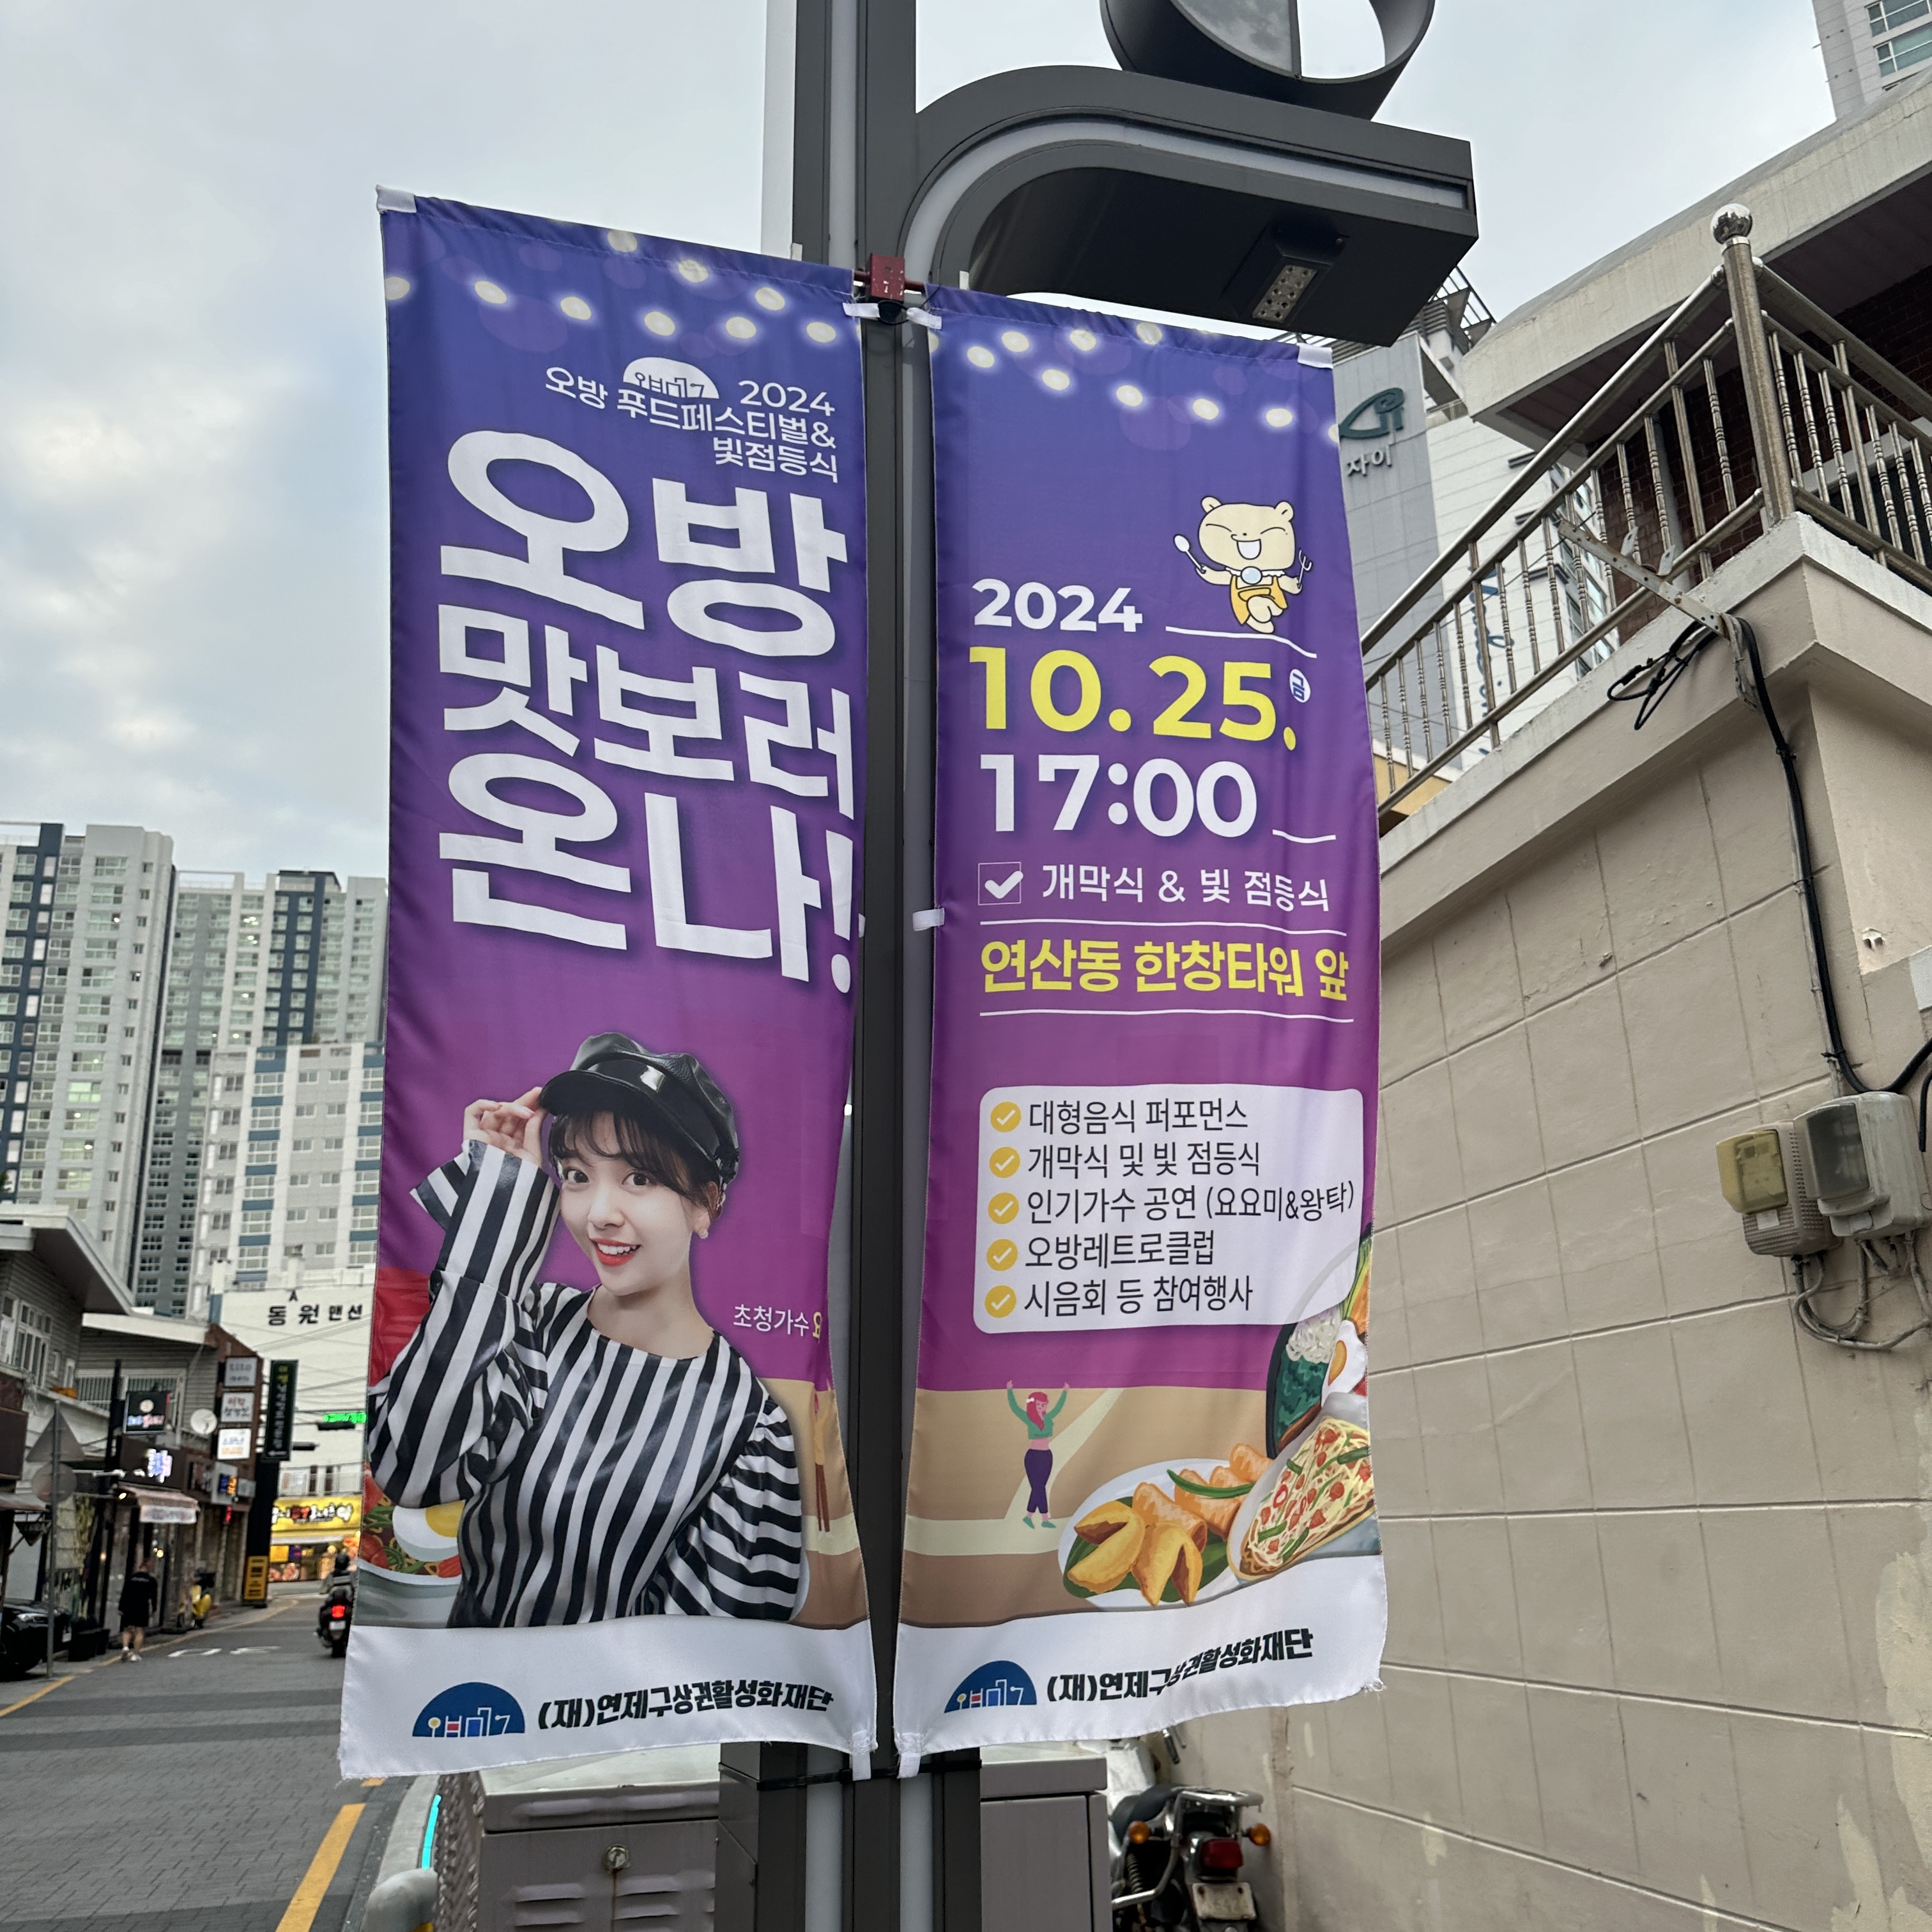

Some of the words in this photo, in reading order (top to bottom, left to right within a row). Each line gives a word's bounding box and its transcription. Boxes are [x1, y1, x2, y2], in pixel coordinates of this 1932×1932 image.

[546, 367, 608, 409] 오방
[738, 380, 835, 416] 2024
[713, 437, 838, 482] 빛점등식
[1347, 445, 1392, 477] 자이
[440, 430, 848, 657] 오방
[972, 578, 1143, 632] 2024
[438, 604, 854, 820] 맛보러
[981, 754, 1257, 838] 17:00
[439, 753, 854, 993] 온나!
[1042, 864, 1144, 903] 개막식
[1158, 870, 1186, 903] &
[1200, 869, 1230, 903] 빛
[1244, 870, 1330, 912] 점등식
[981, 939, 1121, 993] 연산동
[1133, 940, 1304, 997] 한창타워
[1315, 948, 1349, 1001] 앞
[1029, 1100, 1136, 1135] 대형음식
[1146, 1098, 1248, 1133] 퍼포먼스
[1027, 1144, 1108, 1179] 개막식
[1119, 1143, 1144, 1177] 및
[1154, 1142, 1177, 1176] 빛
[1187, 1140, 1260, 1176] 점등식
[1027, 1188, 1136, 1223] 인기가수
[1144, 1185, 1196, 1221] 공연
[1025, 1230, 1214, 1270] 오방레트로클럽
[1024, 1280, 1106, 1317] 시음회
[1116, 1279, 1144, 1314] 등
[1153, 1275, 1254, 1312] 참여행사
[733, 1304, 809, 1337] 초청가수
